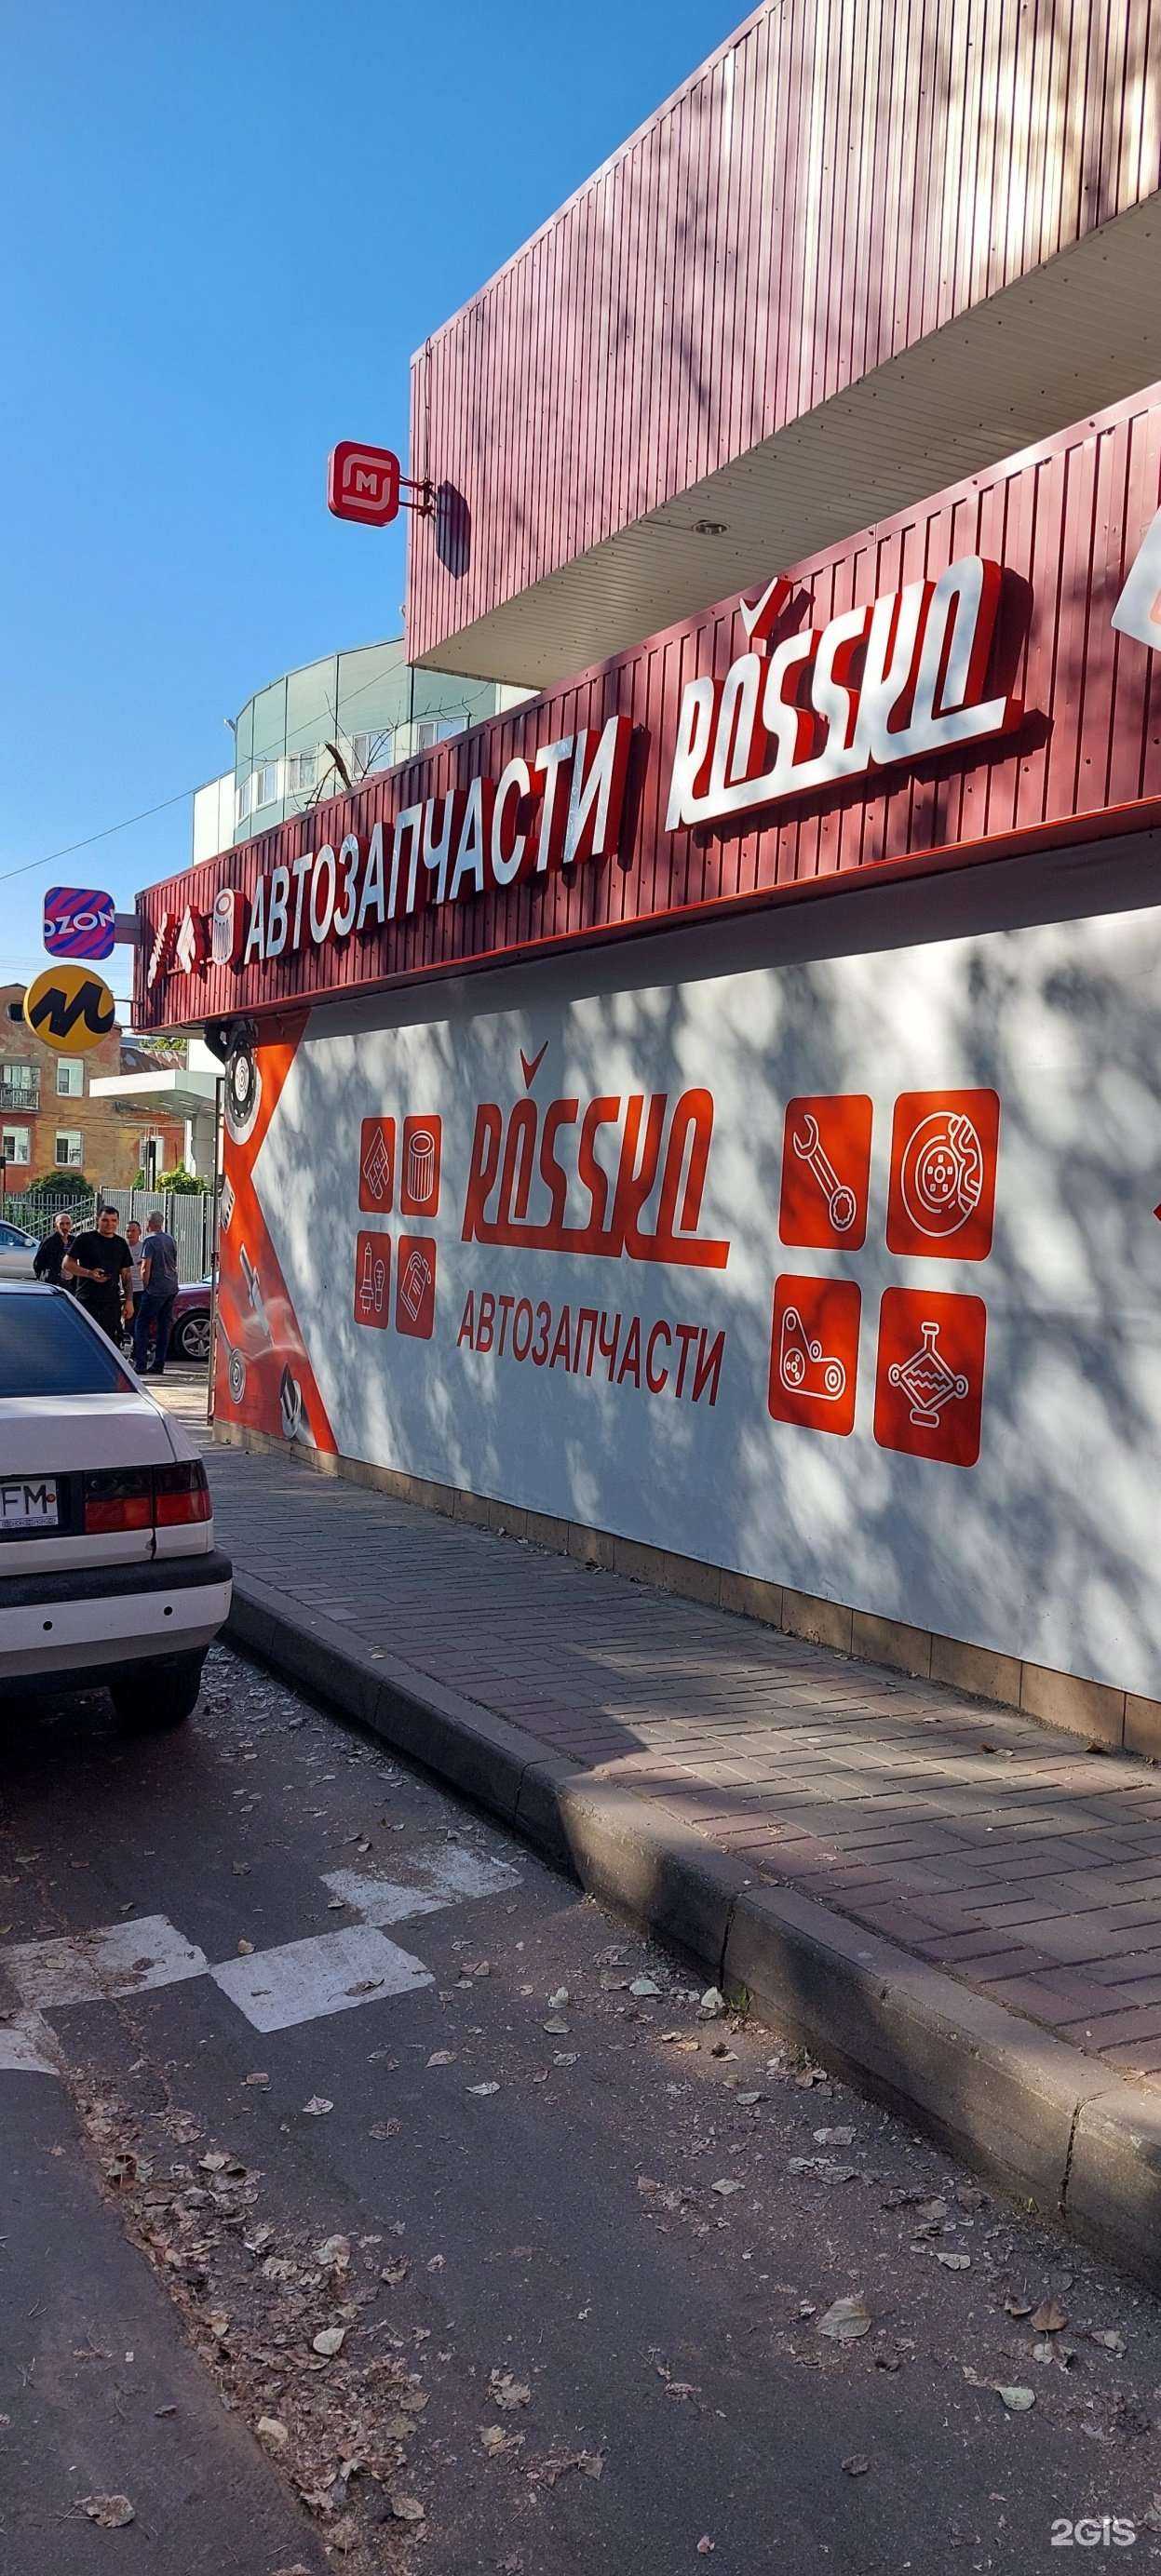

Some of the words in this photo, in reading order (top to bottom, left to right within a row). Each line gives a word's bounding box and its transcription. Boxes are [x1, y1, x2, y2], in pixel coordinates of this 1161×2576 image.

[244, 716, 619, 965] АВТОЗАПЧАСТИ
[456, 1290, 726, 1406] АВТОЗАПЧАСТИ
[1, 1484, 47, 1516] FM
